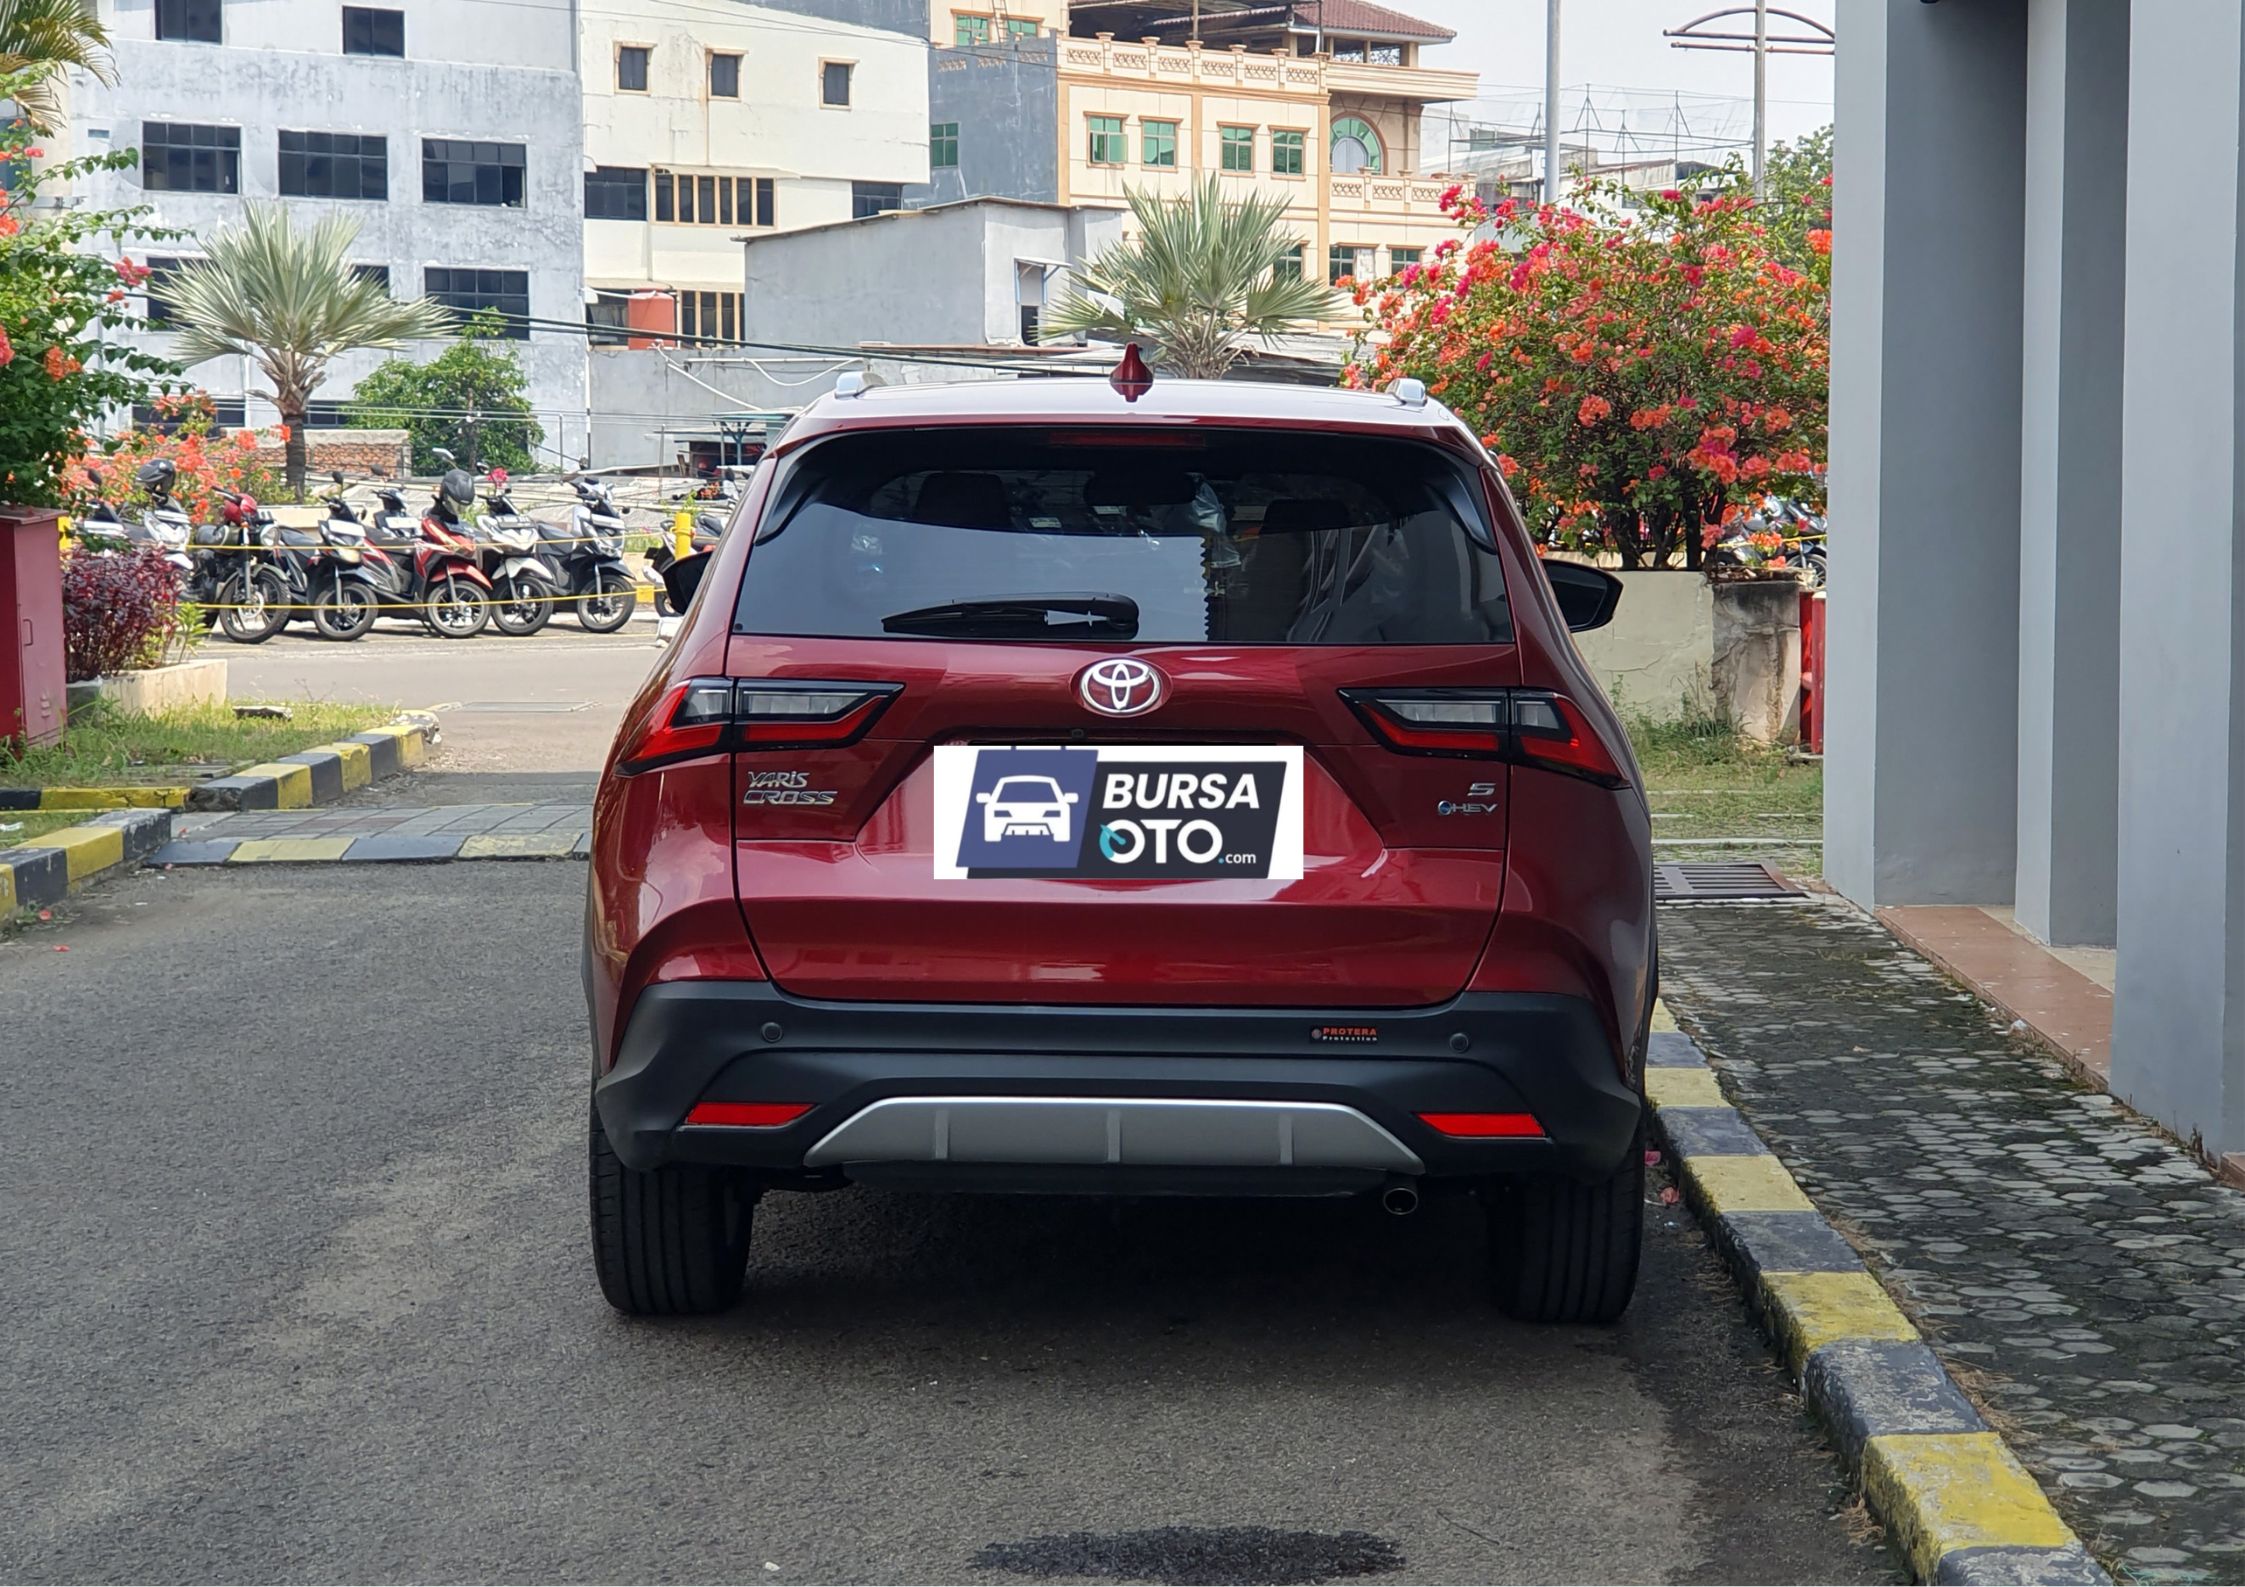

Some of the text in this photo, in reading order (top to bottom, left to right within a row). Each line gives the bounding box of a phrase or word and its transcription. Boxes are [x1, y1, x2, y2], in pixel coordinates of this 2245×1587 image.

[743, 789, 838, 805] CROSS
[1467, 782, 1497, 797] S
[1322, 1027, 1377, 1036] PROTERA
